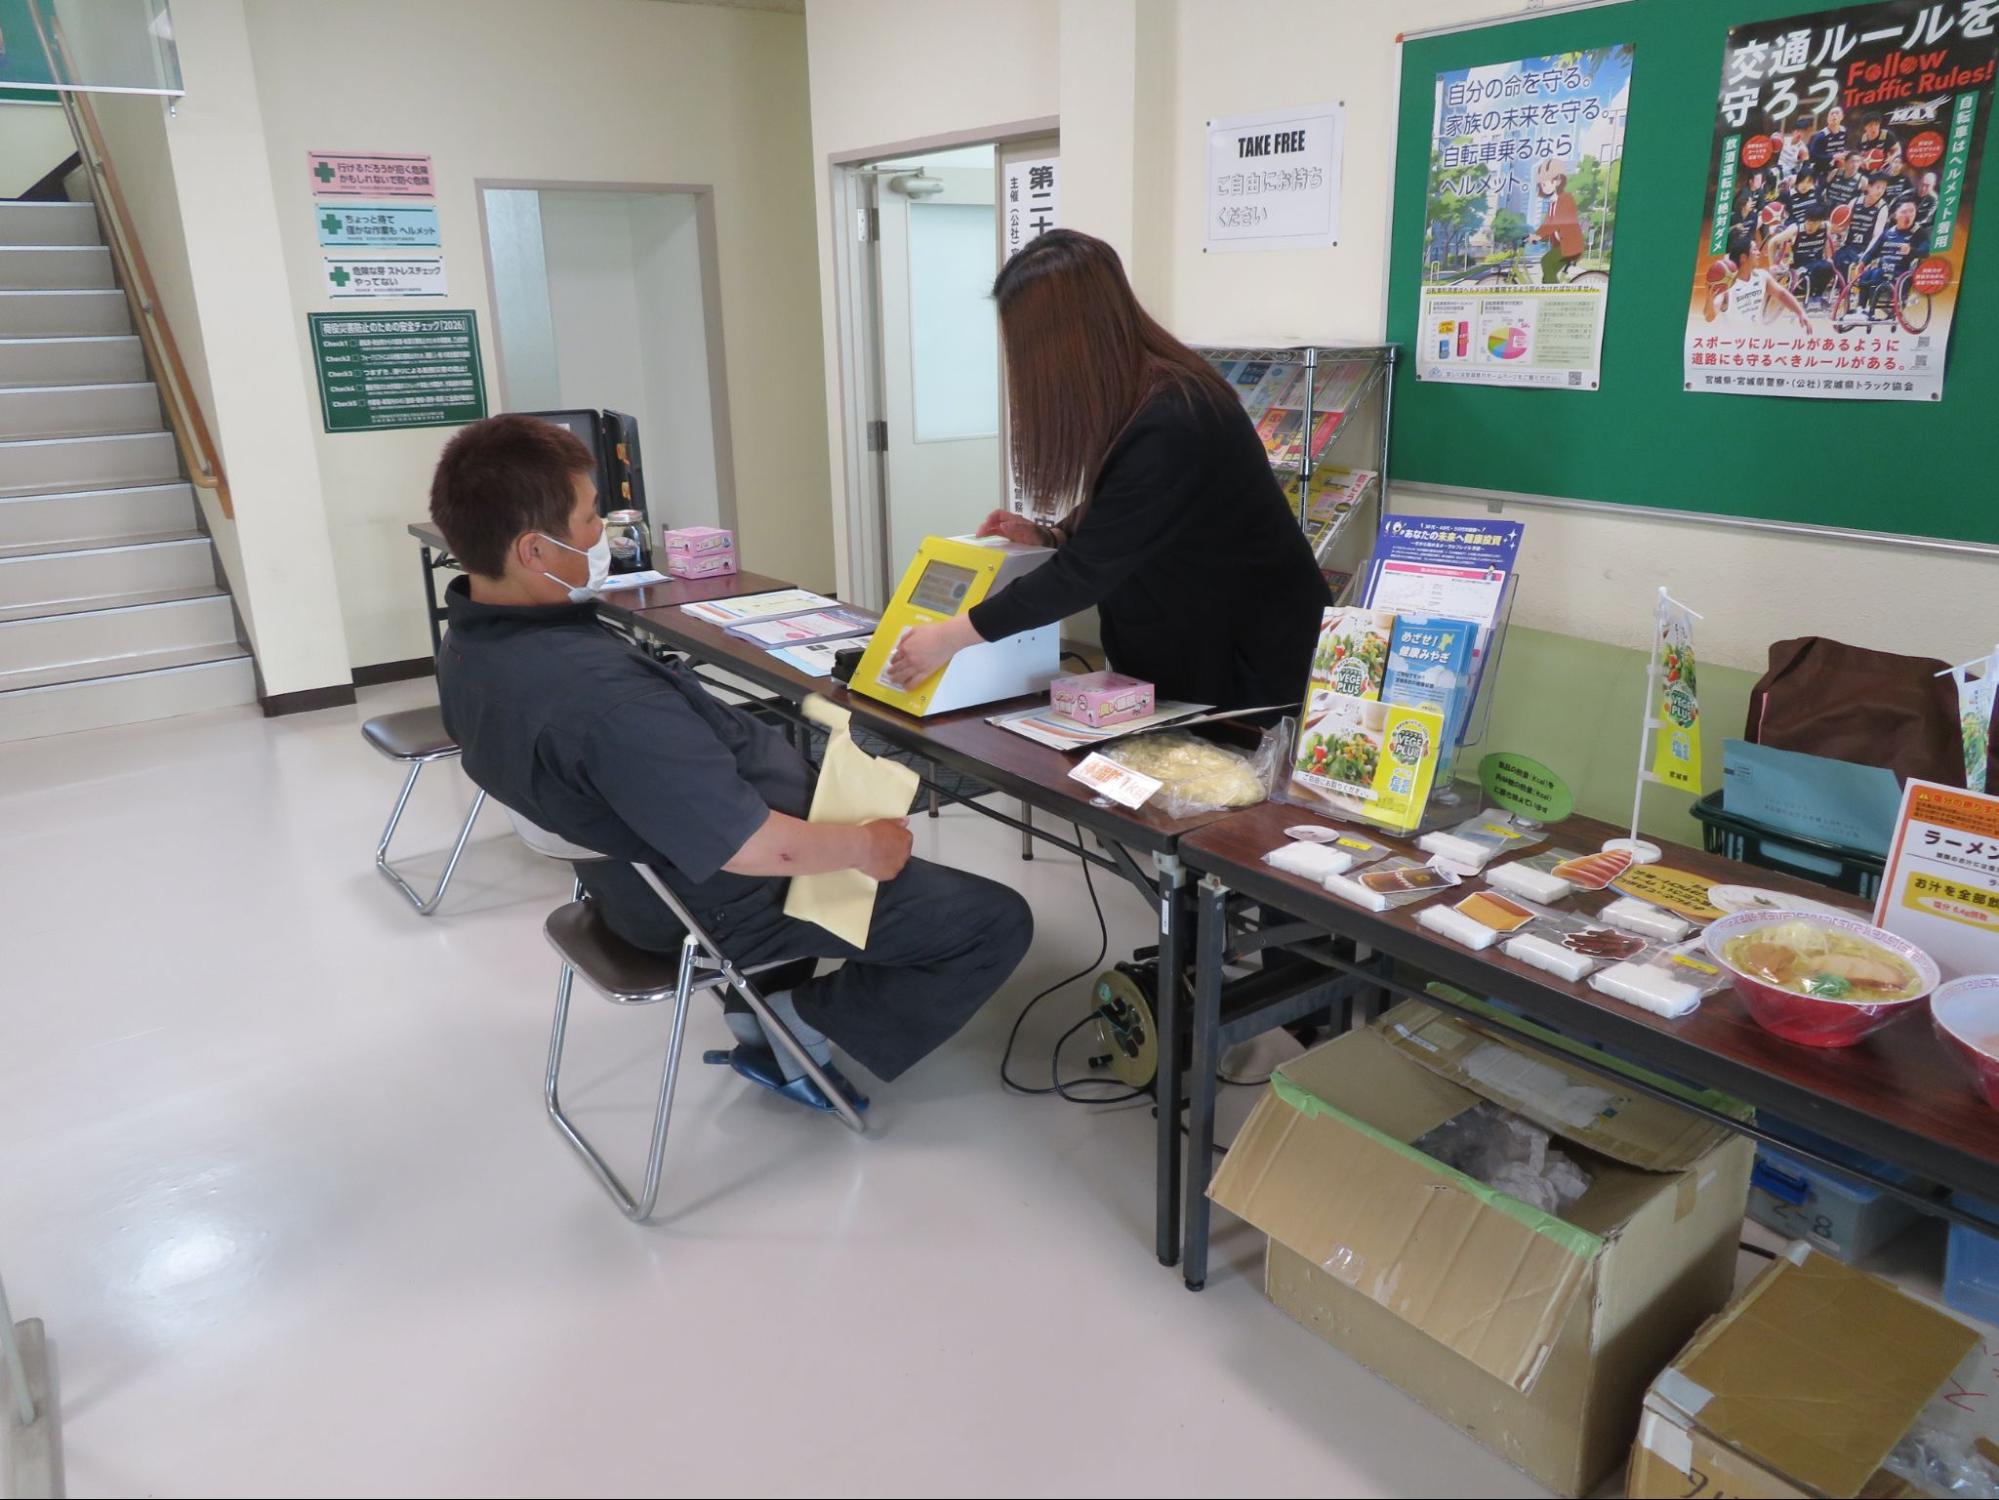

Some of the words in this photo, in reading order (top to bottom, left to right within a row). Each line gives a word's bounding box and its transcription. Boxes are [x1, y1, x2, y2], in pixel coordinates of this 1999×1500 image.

[1727, 0, 1999, 84] 交通ルールを
[1847, 49, 1949, 88] Follow
[1450, 67, 1592, 105] 自分の命を守る。
[1721, 68, 1840, 128] 守ろう
[1843, 81, 1913, 109] Traffic
[1918, 59, 1995, 94] Rules!
[1446, 97, 1610, 137] 家族の未来を守る。
[1237, 136, 1271, 159] TAKE
[1274, 129, 1306, 155] FREE
[1443, 134, 1573, 168] 自転車乗るなら
[1216, 166, 1324, 197] ご自由にお持ち
[1440, 171, 1530, 197] ヘルメット。
[1216, 206, 1269, 228] ください
[1692, 336, 1900, 352] スポーツにルールがあるように
[1691, 352, 1906, 371] 道路にも守るべきルールがある。
[1336, 682, 1361, 695] PLUS
[1339, 673, 1362, 684] VEGE
[1395, 744, 1420, 758] PLUS
[1398, 734, 1423, 747] VEGE
